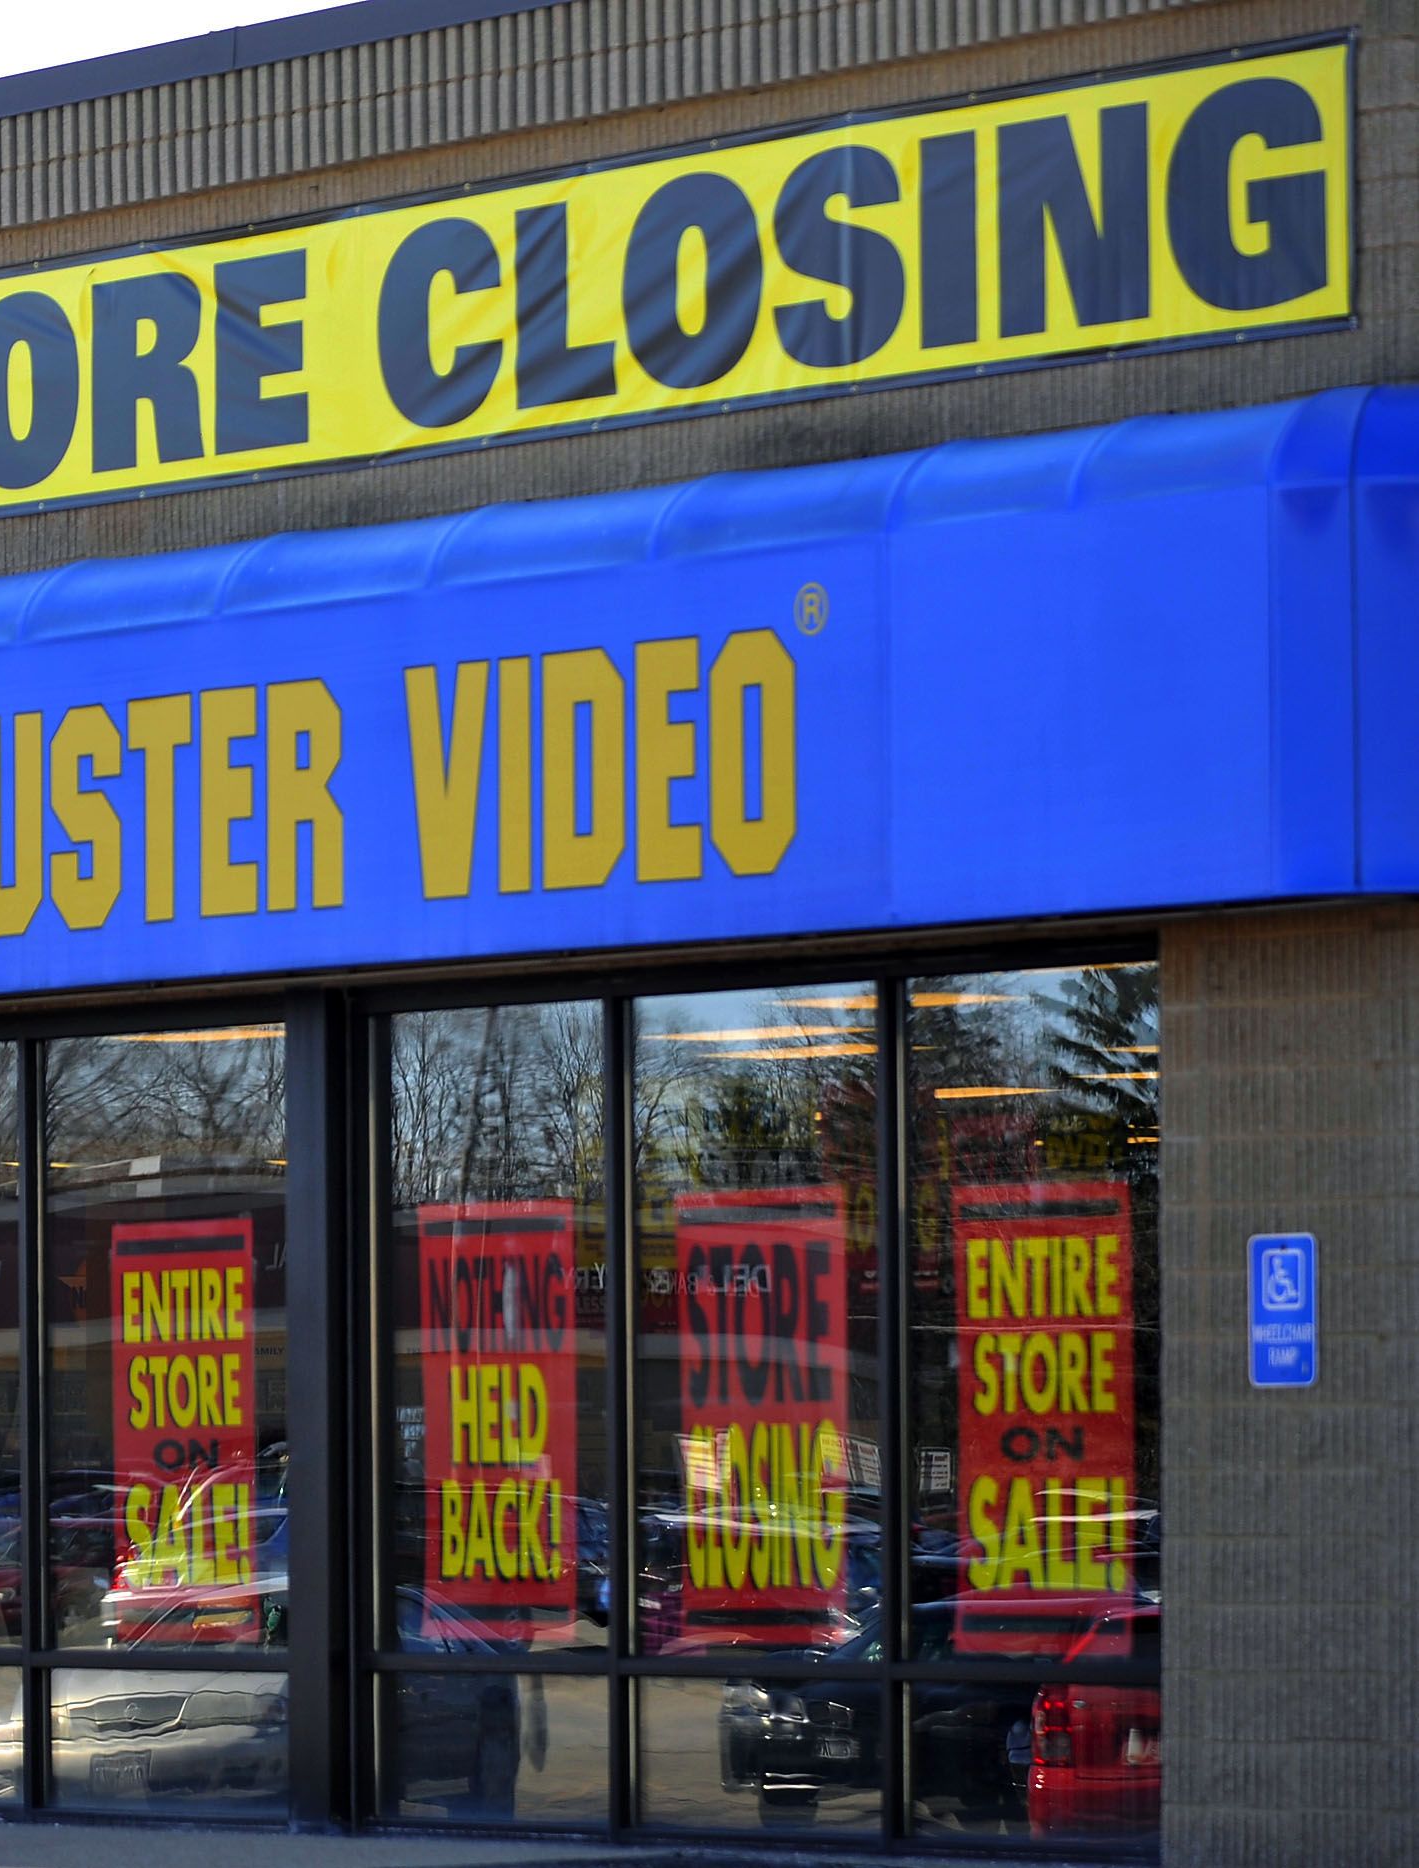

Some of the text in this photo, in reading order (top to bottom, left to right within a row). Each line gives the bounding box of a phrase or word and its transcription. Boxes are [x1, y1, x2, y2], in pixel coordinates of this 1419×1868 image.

[377, 76, 1328, 428] CLOSING
[403, 627, 796, 900] VIDEO
[122, 1266, 246, 1344] ENTIRE
[429, 1253, 568, 1354] NOTHING
[687, 1240, 833, 1409] STORE
[965, 1233, 1120, 1319] ENTIRE
[973, 1331, 1117, 1416] STORE
[1251, 1322, 1314, 1343] WHEELCHAIR
[1267, 1345, 1299, 1367] RAMP
[129, 1353, 242, 1430] STORE
[450, 1363, 549, 1465] HELD
[153, 1439, 219, 1471] ON
[1000, 1426, 1086, 1462] ON
[125, 1484, 251, 1587] SALE!
[441, 1479, 562, 1580] BACK!
[686, 1419, 847, 1590] CLOSING
[967, 1475, 1127, 1592] SALE!
